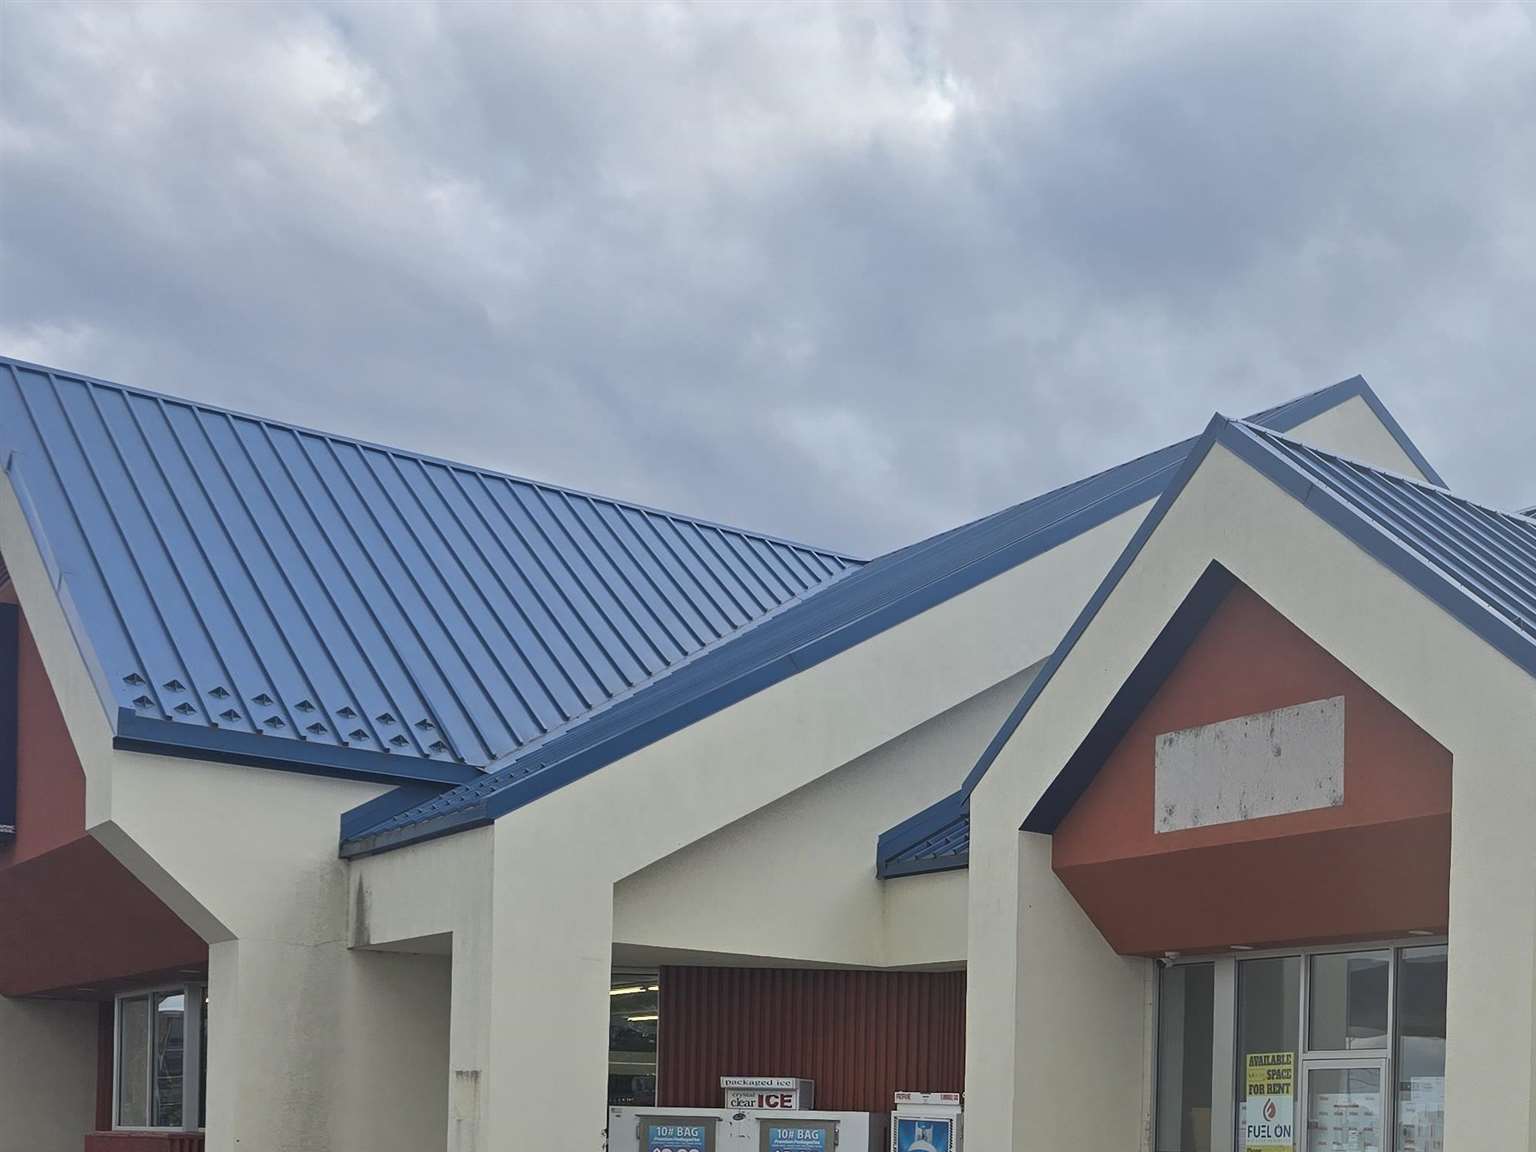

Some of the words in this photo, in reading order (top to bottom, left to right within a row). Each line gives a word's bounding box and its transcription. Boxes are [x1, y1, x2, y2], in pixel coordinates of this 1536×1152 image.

[1248, 1054, 1292, 1067] AVAILABLE
[1266, 1068, 1292, 1080] SPACE
[725, 1079, 773, 1087] packaged
[1248, 1083, 1265, 1095] FOR
[1266, 1082, 1291, 1095] RENT
[730, 1098, 756, 1107] clear
[757, 1093, 793, 1108] ICE
[656, 1126, 674, 1137] 10#
[677, 1126, 699, 1137] BAG
[777, 1128, 795, 1139] 10#
[797, 1129, 819, 1139] BAG
[1247, 1124, 1272, 1138] FUEL
[1274, 1124, 1292, 1138] ON
